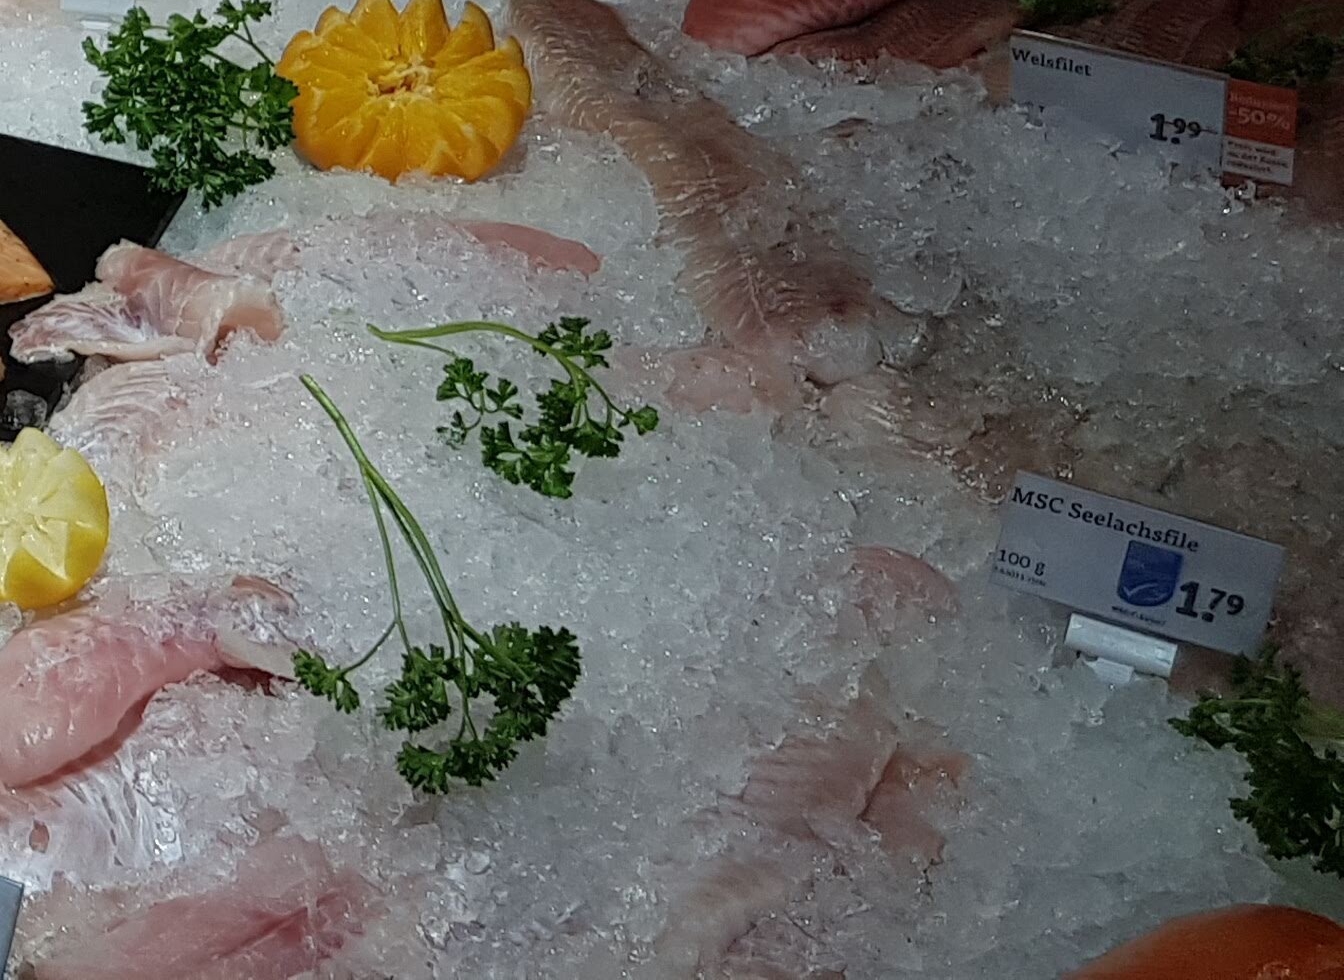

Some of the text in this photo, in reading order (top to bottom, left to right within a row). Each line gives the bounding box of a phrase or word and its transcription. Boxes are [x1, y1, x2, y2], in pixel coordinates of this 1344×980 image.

[1012, 48, 1092, 76] Welsfilet
[1149, 113, 1202, 145] 1.99
[1228, 106, 1291, 130] -50%
[1012, 487, 1199, 553] MSC Seelachsfile
[997, 549, 1030, 569] 100
[1034, 560, 1046, 577] g
[1175, 581, 1245, 622] 1.79
